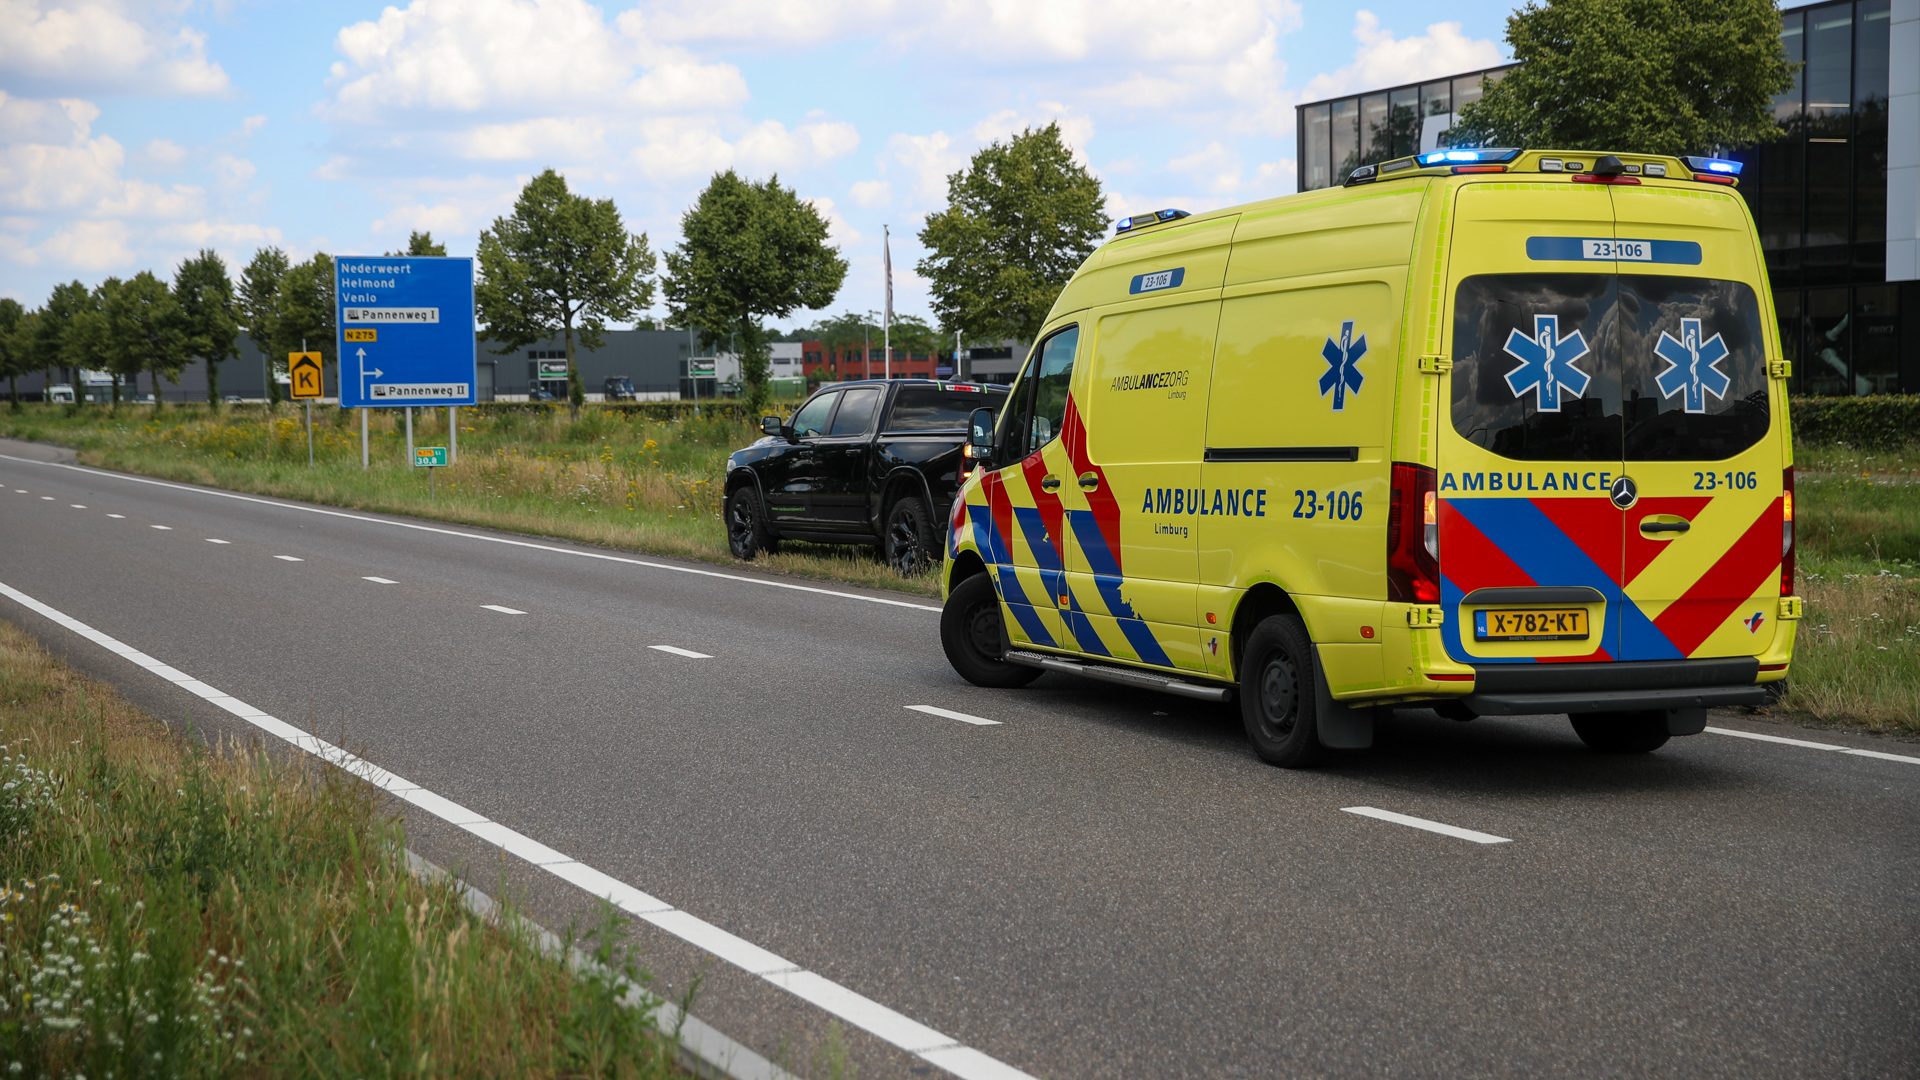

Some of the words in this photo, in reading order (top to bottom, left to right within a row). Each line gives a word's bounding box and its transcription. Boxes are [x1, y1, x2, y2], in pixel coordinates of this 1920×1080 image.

[1592, 243, 1643, 257] 23-106
[341, 264, 411, 274] Nederweert
[342, 278, 395, 288] Helmond
[1145, 274, 1168, 288] 23-106
[342, 293, 377, 303] Venlo
[362, 310, 427, 322] Pannenweg
[300, 372, 313, 388] K
[1110, 370, 1190, 392] AMBULANCEZORG
[389, 386, 453, 397] Pannenweg
[457, 385, 465, 395] II
[1168, 390, 1187, 400] Limburg
[1440, 472, 1611, 491] AMBULANCE
[1693, 471, 1757, 490] 23-106
[1142, 488, 1267, 516] AMBULANCE
[1293, 489, 1363, 520] 23-106
[1154, 523, 1188, 538] Limburg
[1494, 613, 1579, 633] X-782-KT
